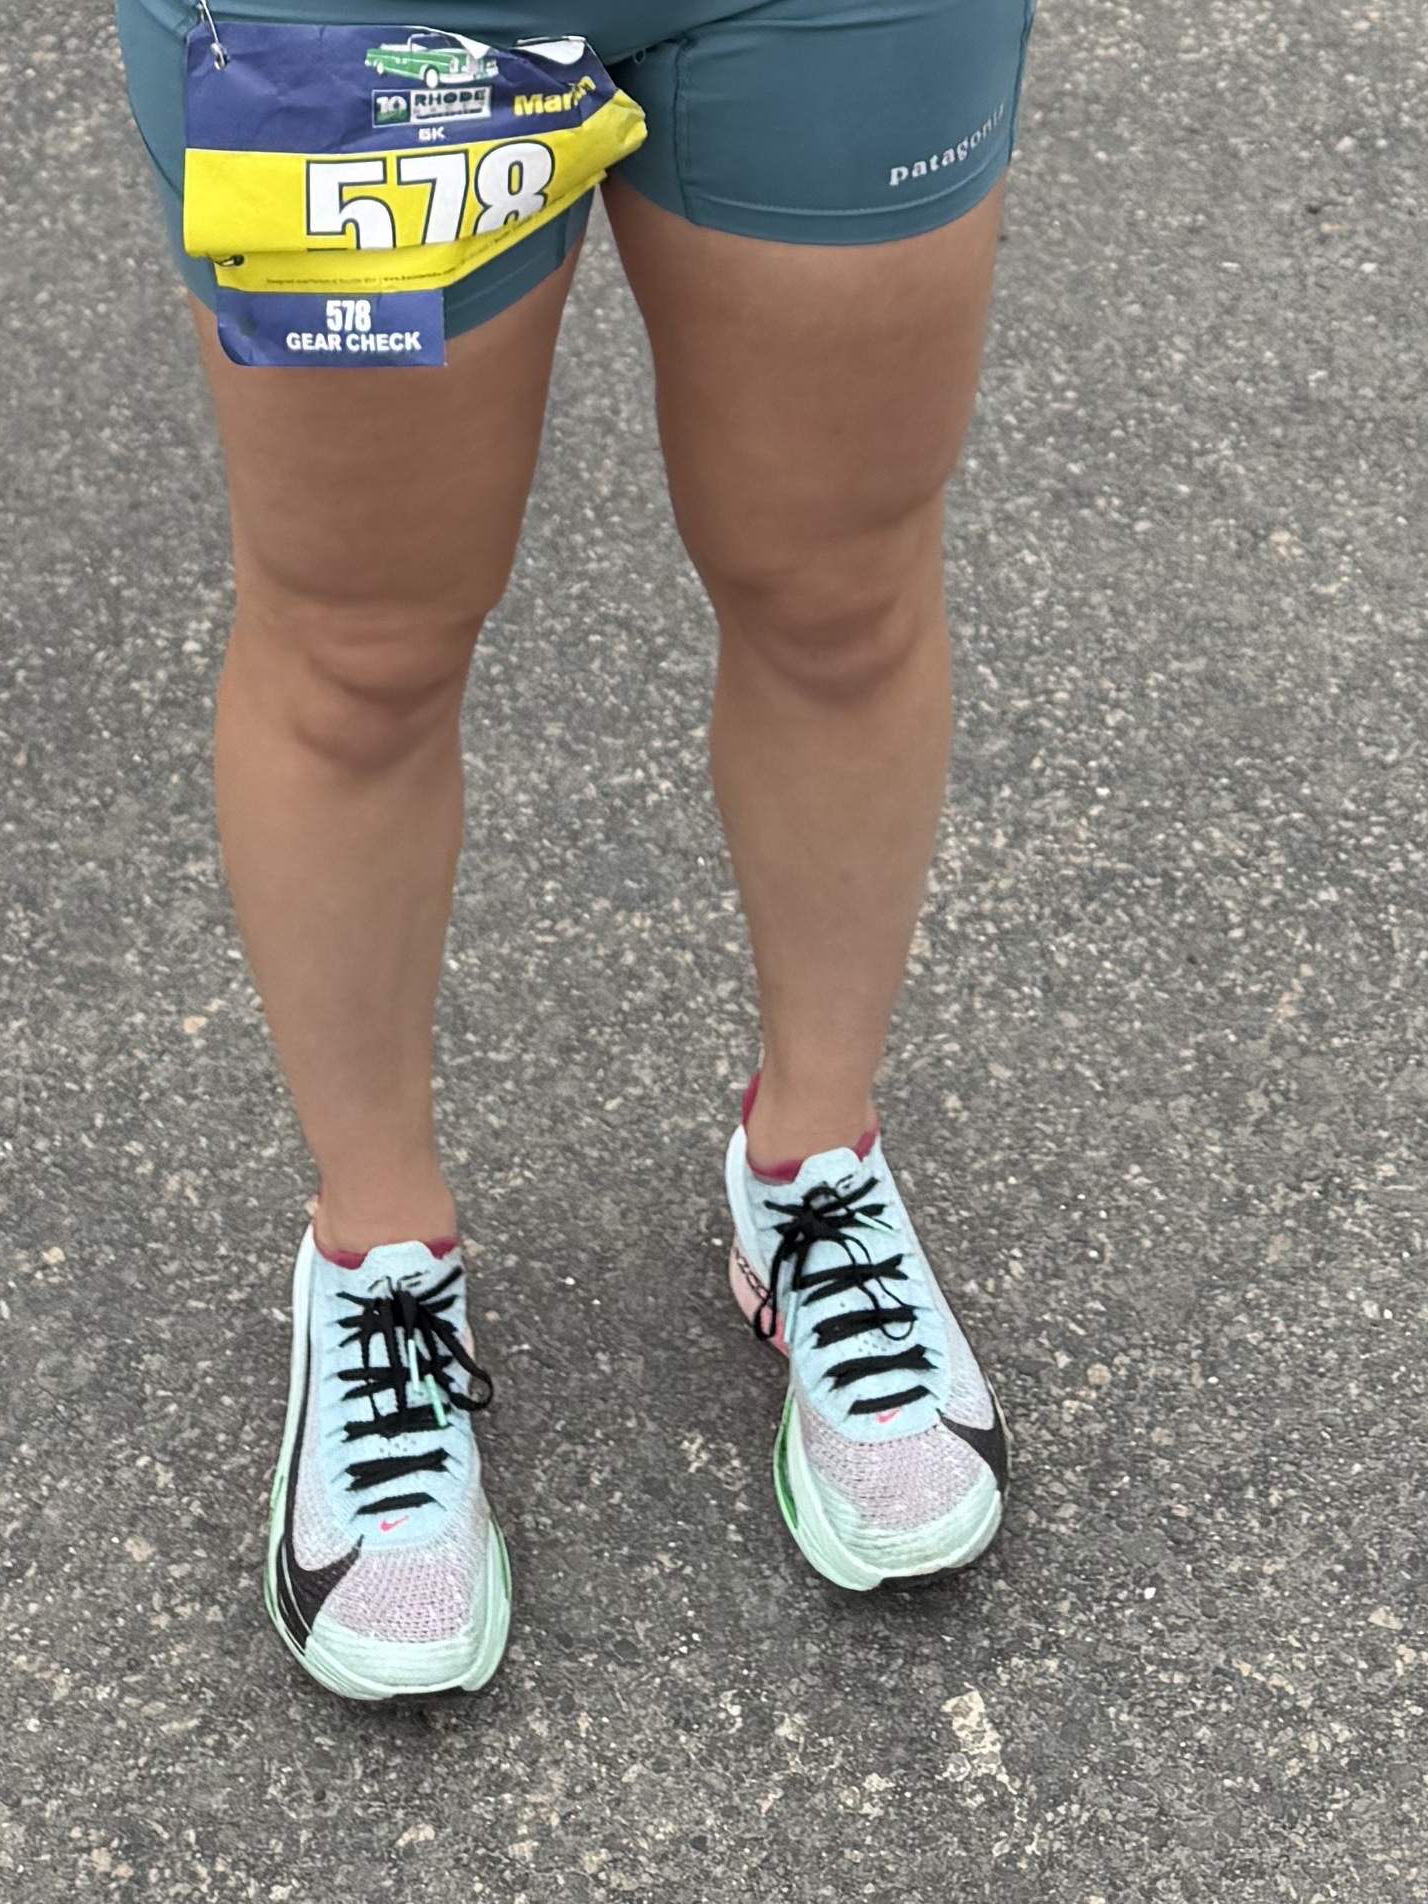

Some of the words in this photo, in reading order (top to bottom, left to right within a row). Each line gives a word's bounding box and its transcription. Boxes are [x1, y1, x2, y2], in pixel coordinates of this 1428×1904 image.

[414, 88, 486, 107] RHODE
[305, 139, 556, 252] 578
[326, 299, 372, 332] 578
[285, 332, 342, 351] GEAR
[346, 330, 422, 352] CHECK
